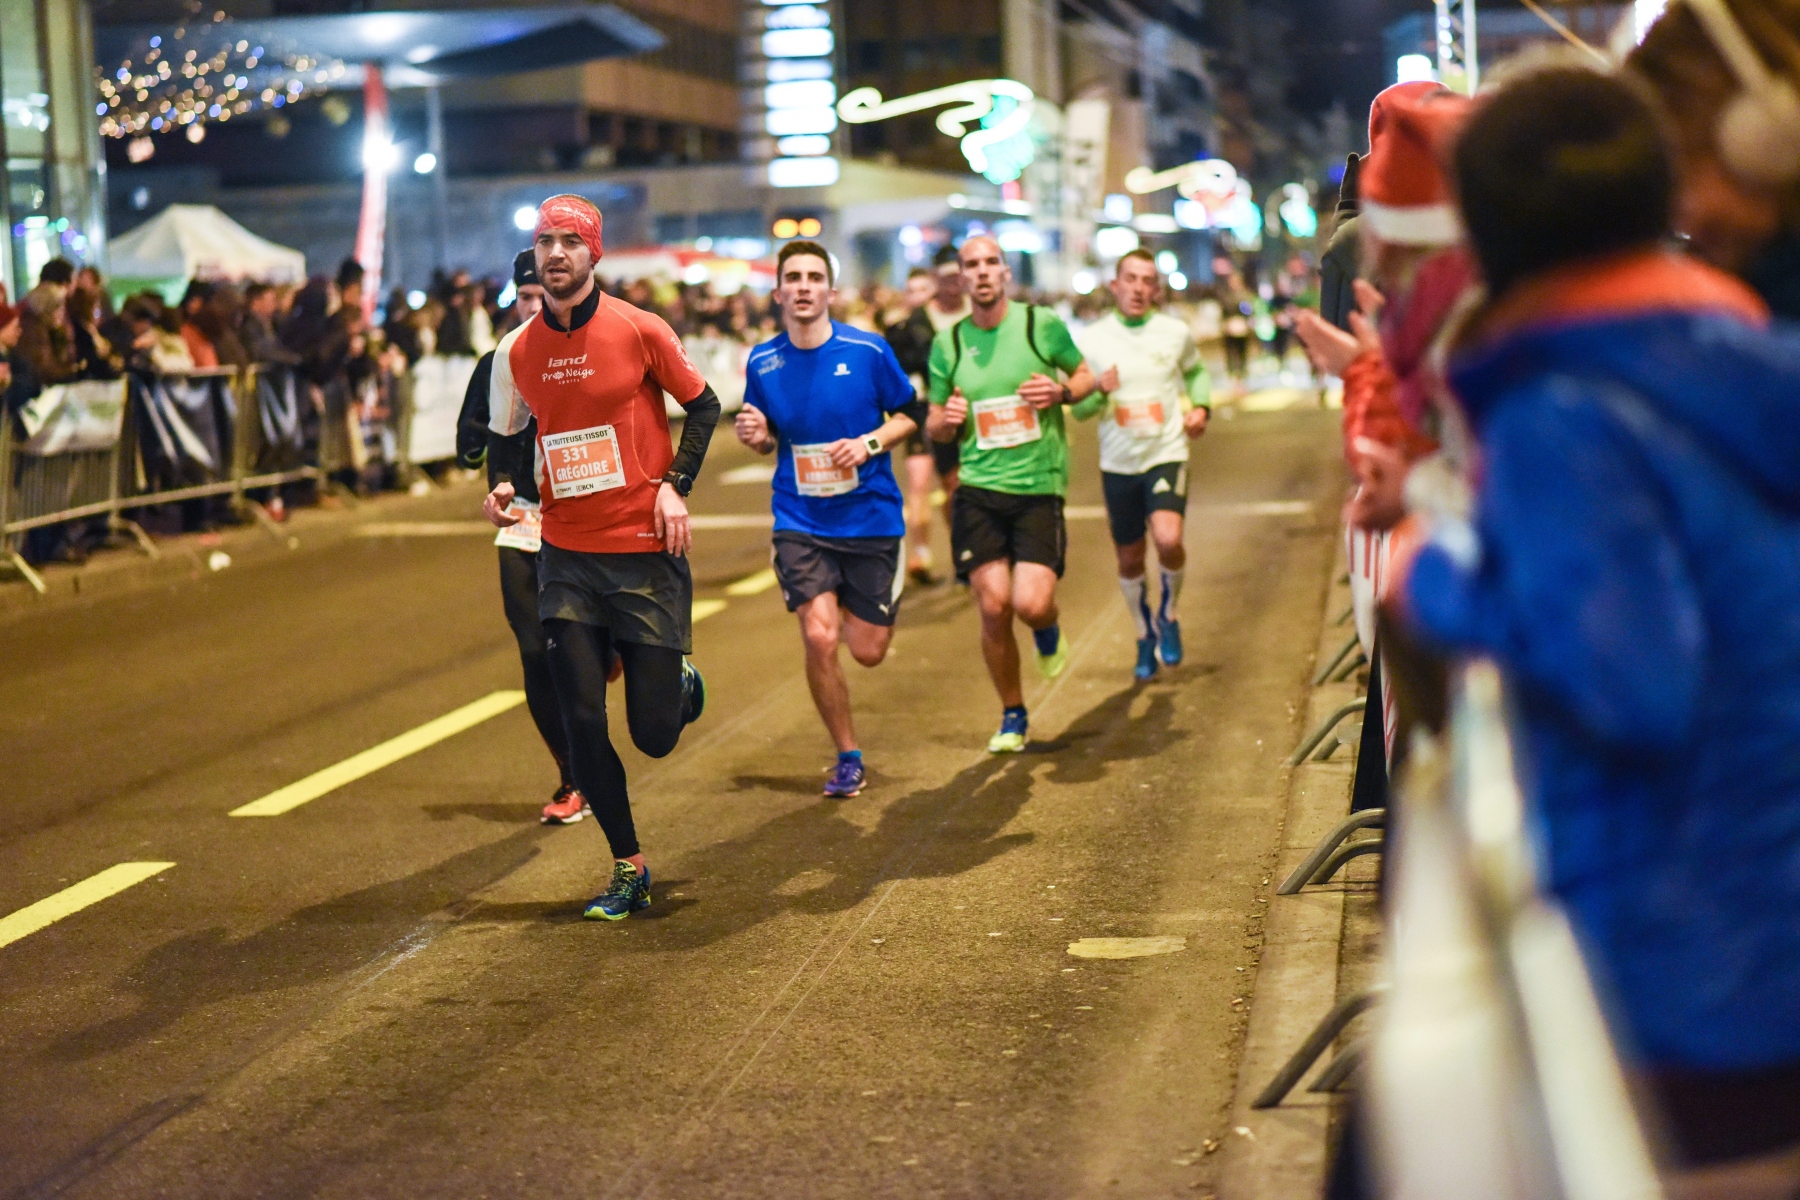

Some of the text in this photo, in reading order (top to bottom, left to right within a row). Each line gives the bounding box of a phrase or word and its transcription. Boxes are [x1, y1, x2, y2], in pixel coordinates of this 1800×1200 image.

[548, 353, 588, 368] land
[566, 368, 596, 379] Neige
[552, 430, 609, 446] TROTTEUSE-TISSOT
[562, 446, 589, 463] 331
[556, 460, 610, 482] GRÉGOIRE
